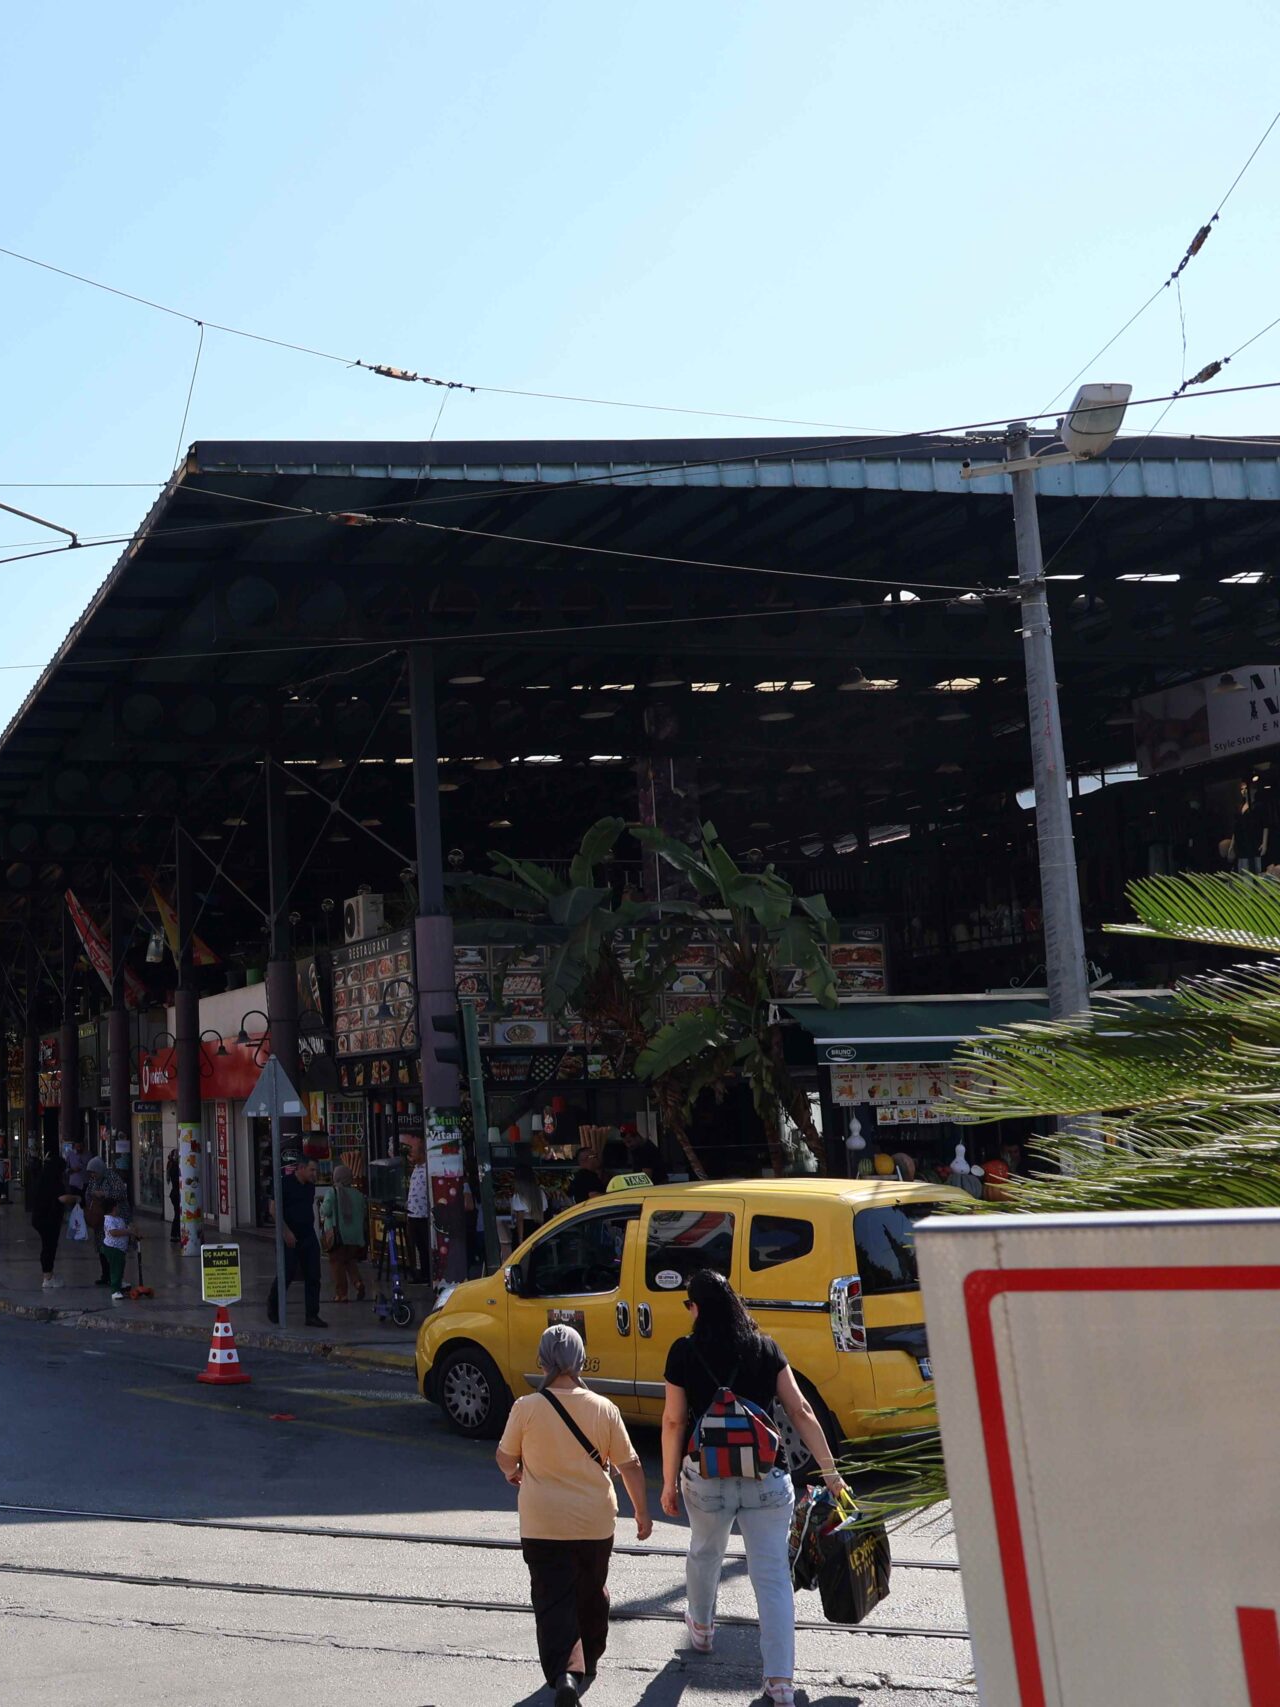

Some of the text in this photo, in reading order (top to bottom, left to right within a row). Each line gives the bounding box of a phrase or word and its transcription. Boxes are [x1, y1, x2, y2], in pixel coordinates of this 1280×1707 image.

[1214, 734, 1261, 752] Style Store
[348, 938, 390, 959] RESTAURANT
